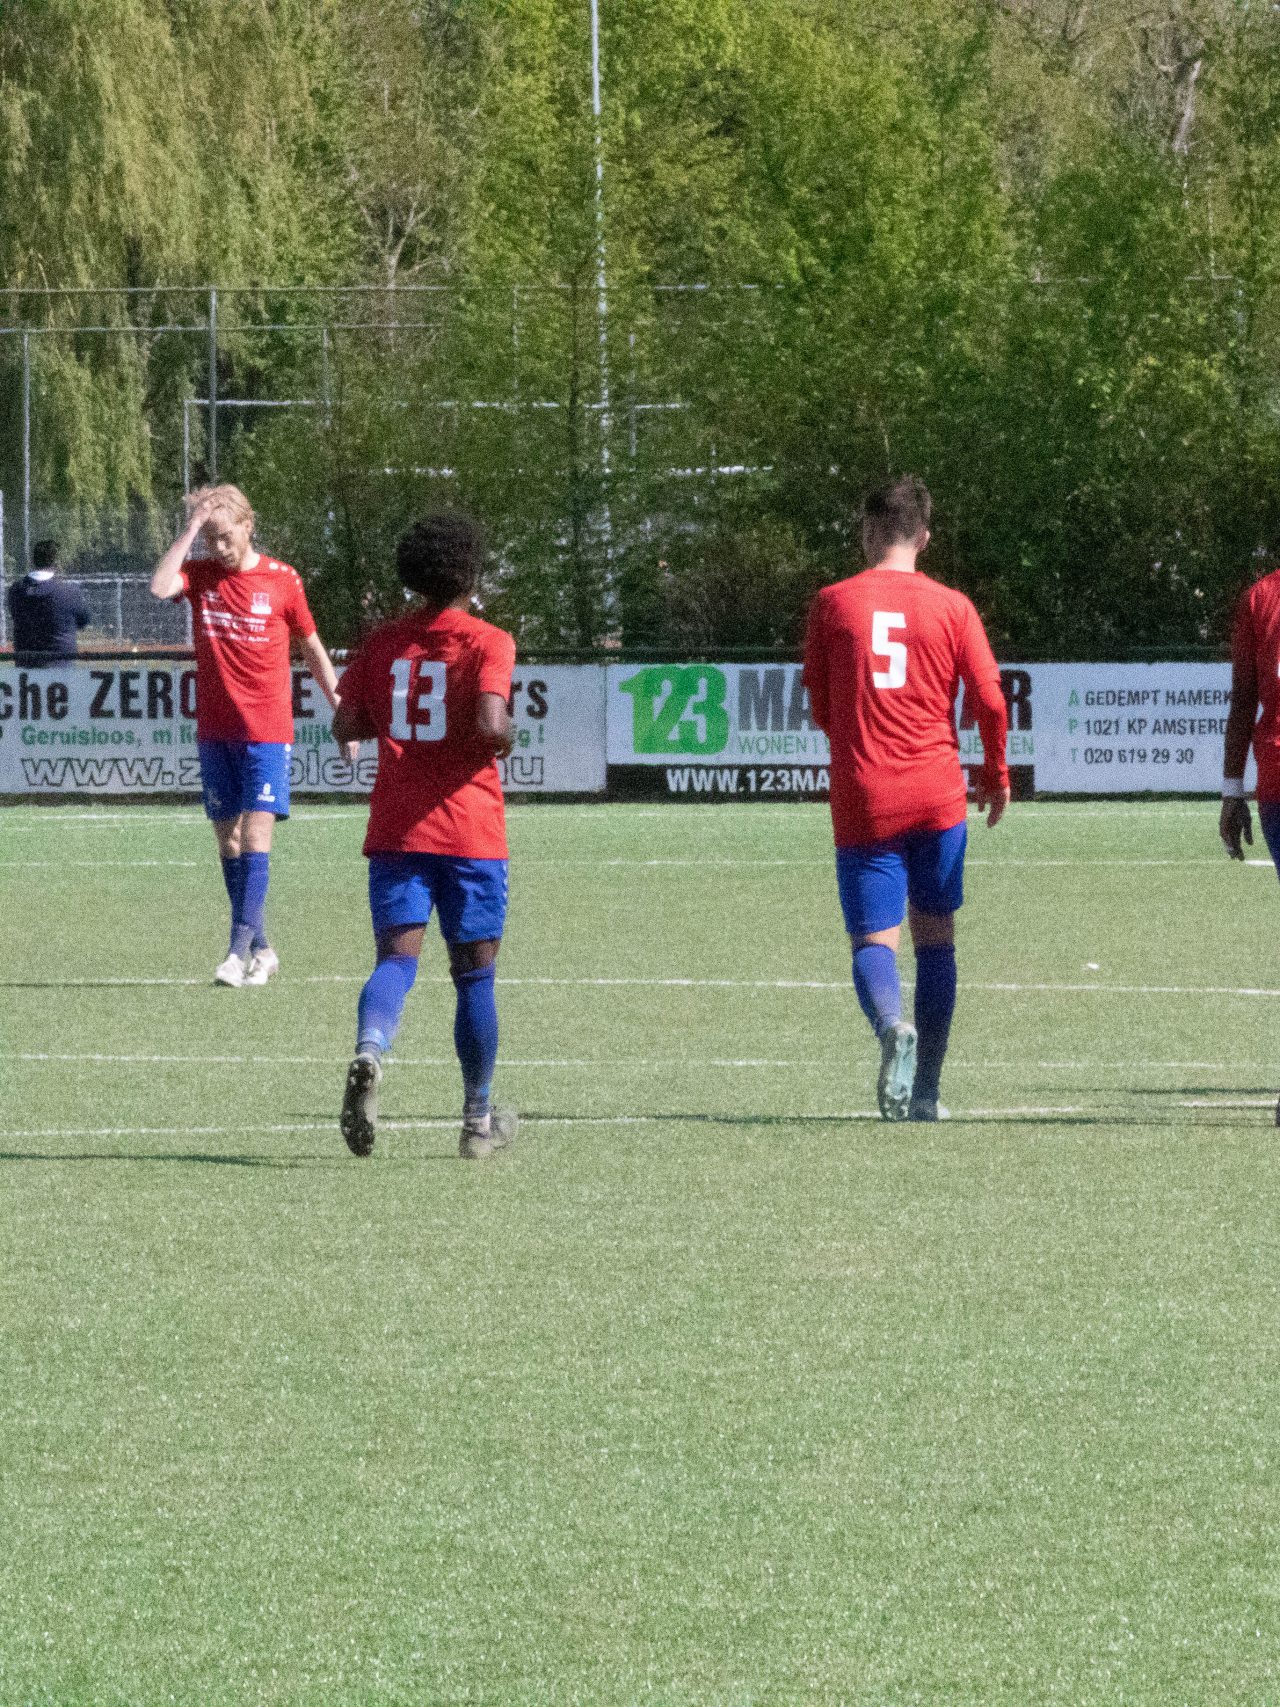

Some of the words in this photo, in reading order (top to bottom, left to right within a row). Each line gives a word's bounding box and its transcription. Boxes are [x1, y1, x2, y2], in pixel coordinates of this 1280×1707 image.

[872, 611, 907, 689] 5
[390, 658, 448, 742] 13
[1085, 689, 1161, 707] GEDEMPT
[619, 665, 730, 755] 123
[1085, 718, 1120, 736] 1021
[1127, 718, 1148, 736] KP
[738, 734, 807, 755] WONEN
[1084, 748, 1113, 765] 020
[1152, 748, 1170, 765] 29
[1175, 748, 1195, 765] 30
